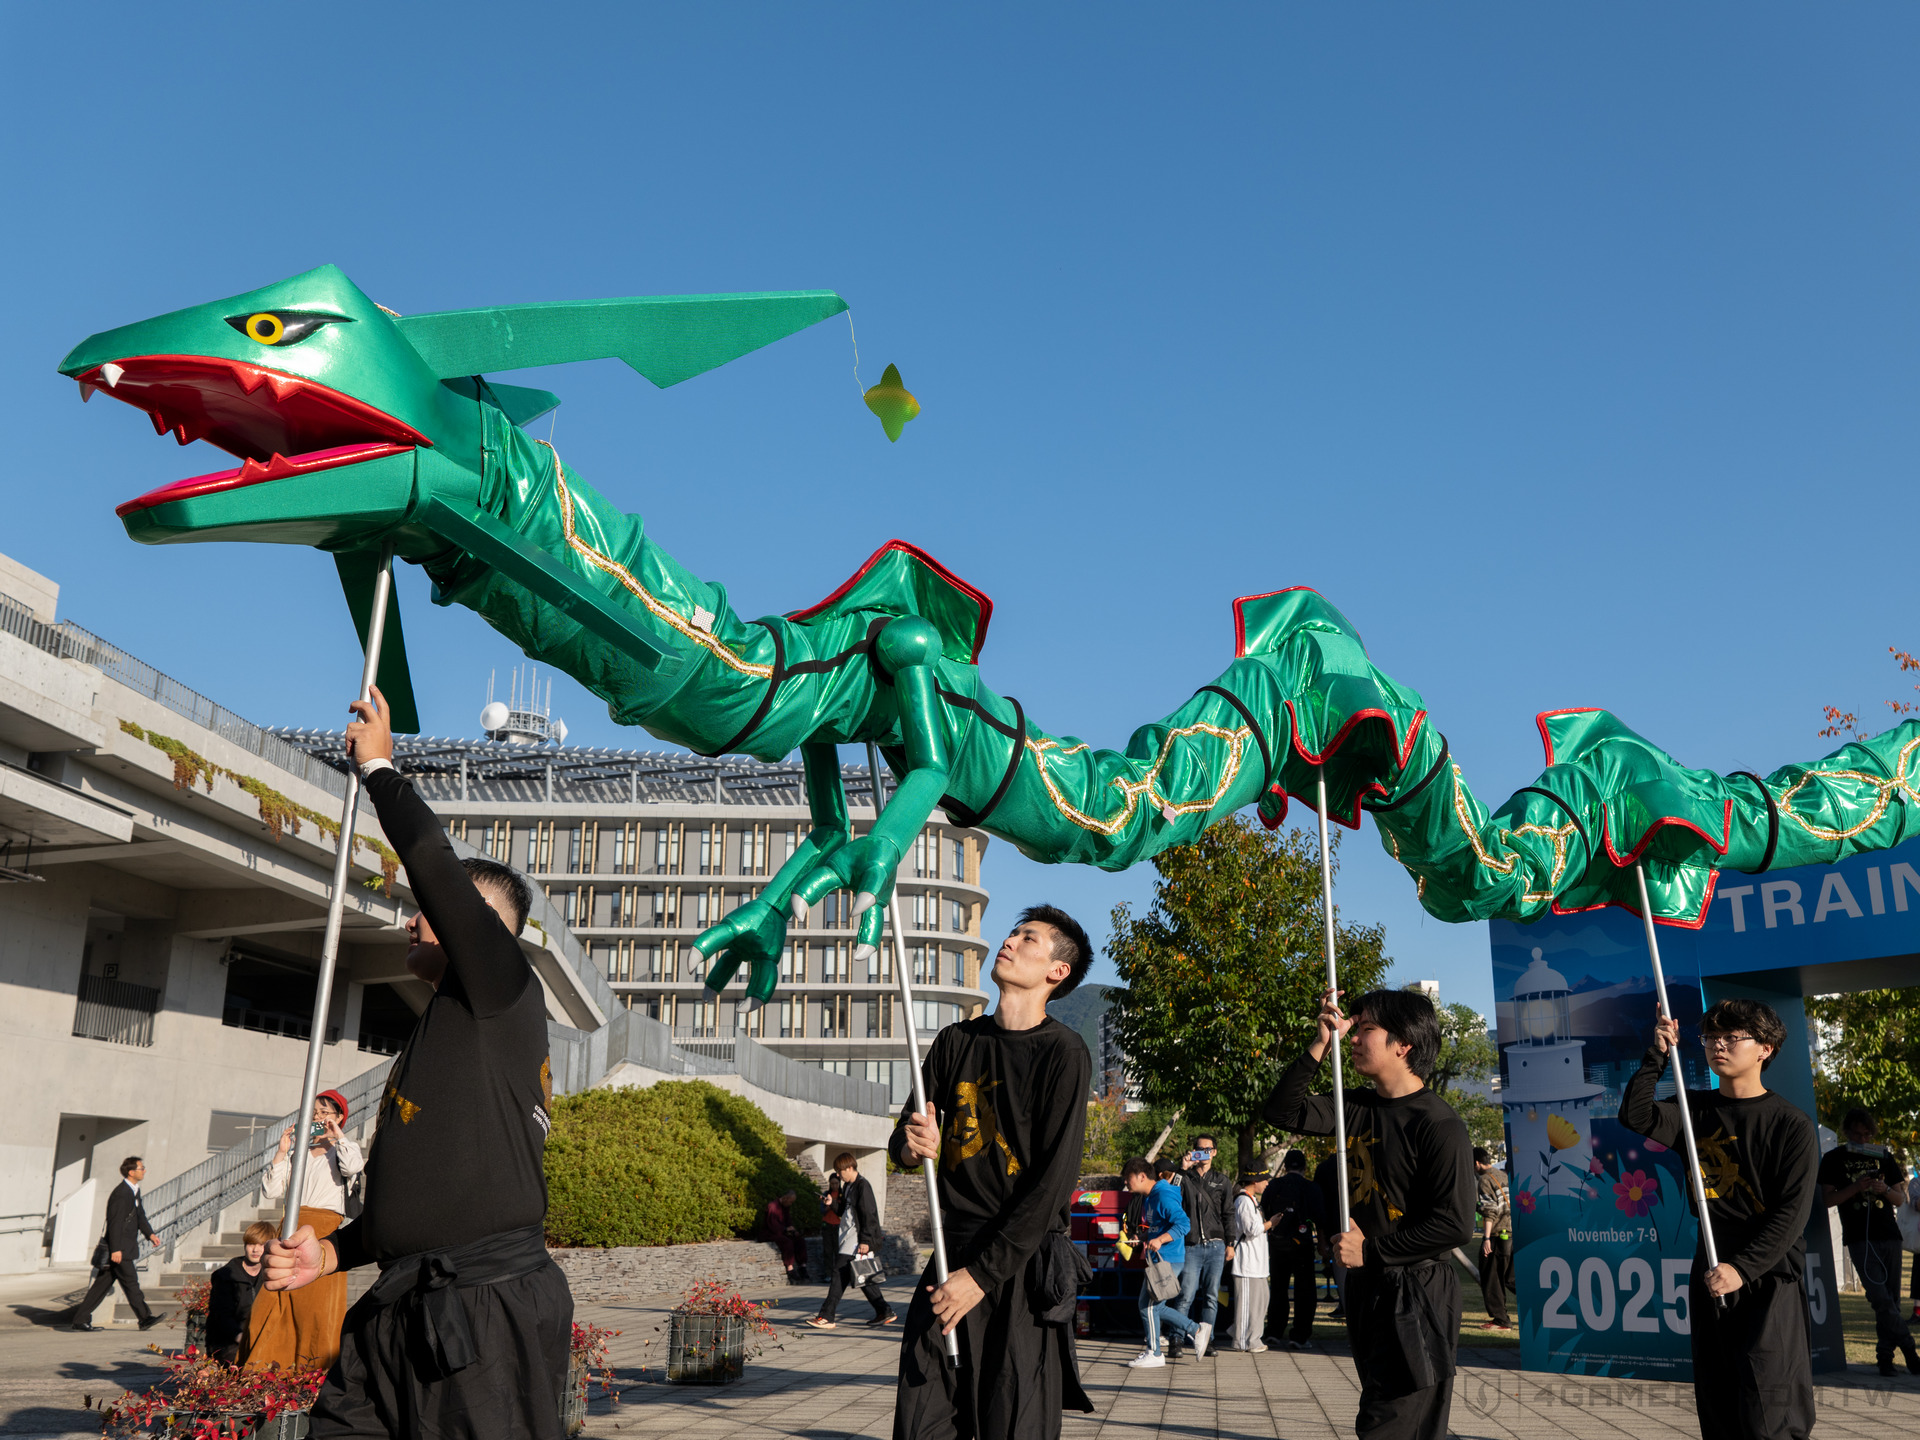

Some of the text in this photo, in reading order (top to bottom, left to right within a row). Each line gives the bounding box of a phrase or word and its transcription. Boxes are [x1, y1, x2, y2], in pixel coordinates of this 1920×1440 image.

[1568, 1228, 1658, 1243] November 7-9
[1539, 1256, 1692, 1336] 2025
